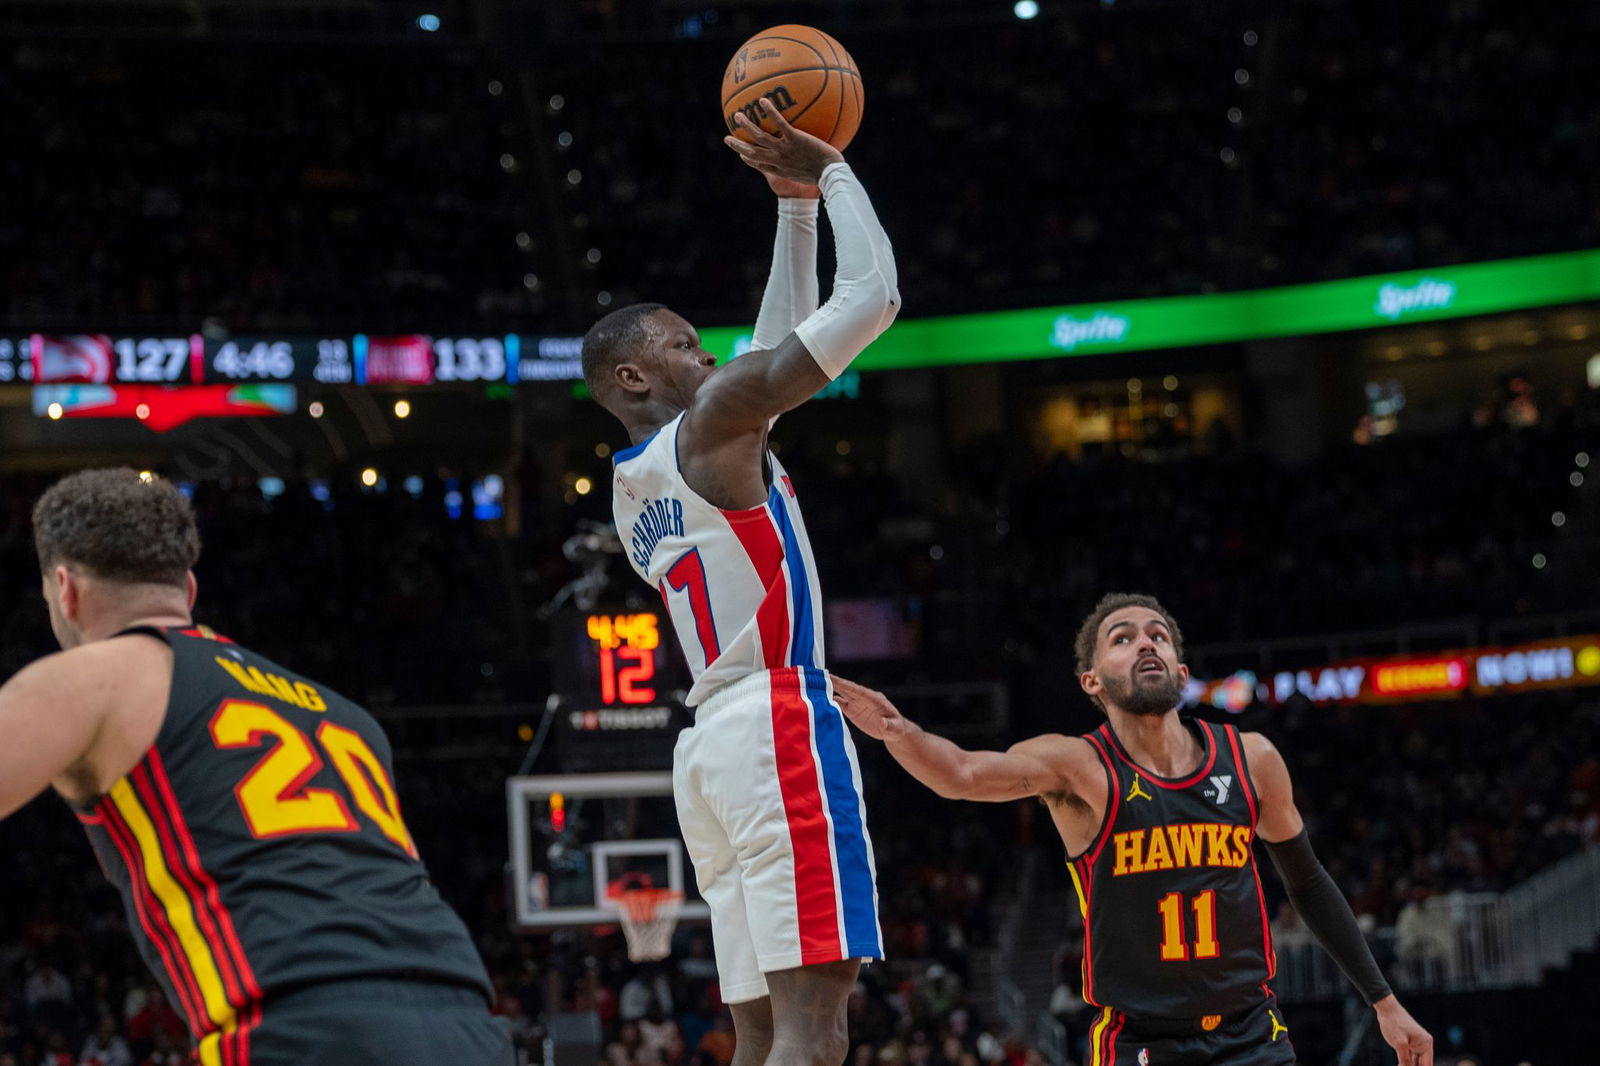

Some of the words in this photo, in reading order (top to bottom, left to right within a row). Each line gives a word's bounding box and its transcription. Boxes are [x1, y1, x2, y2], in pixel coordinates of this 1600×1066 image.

[114, 338, 189, 381] 127
[213, 341, 295, 378] 4:46
[434, 338, 505, 381] 133
[632, 498, 685, 577] SCHRÖDER
[600, 646, 656, 704] 12
[1274, 666, 1365, 702] PLAY
[208, 698, 419, 861] 20
[1112, 823, 1251, 877] HAWKS
[1158, 888, 1221, 962] 11
